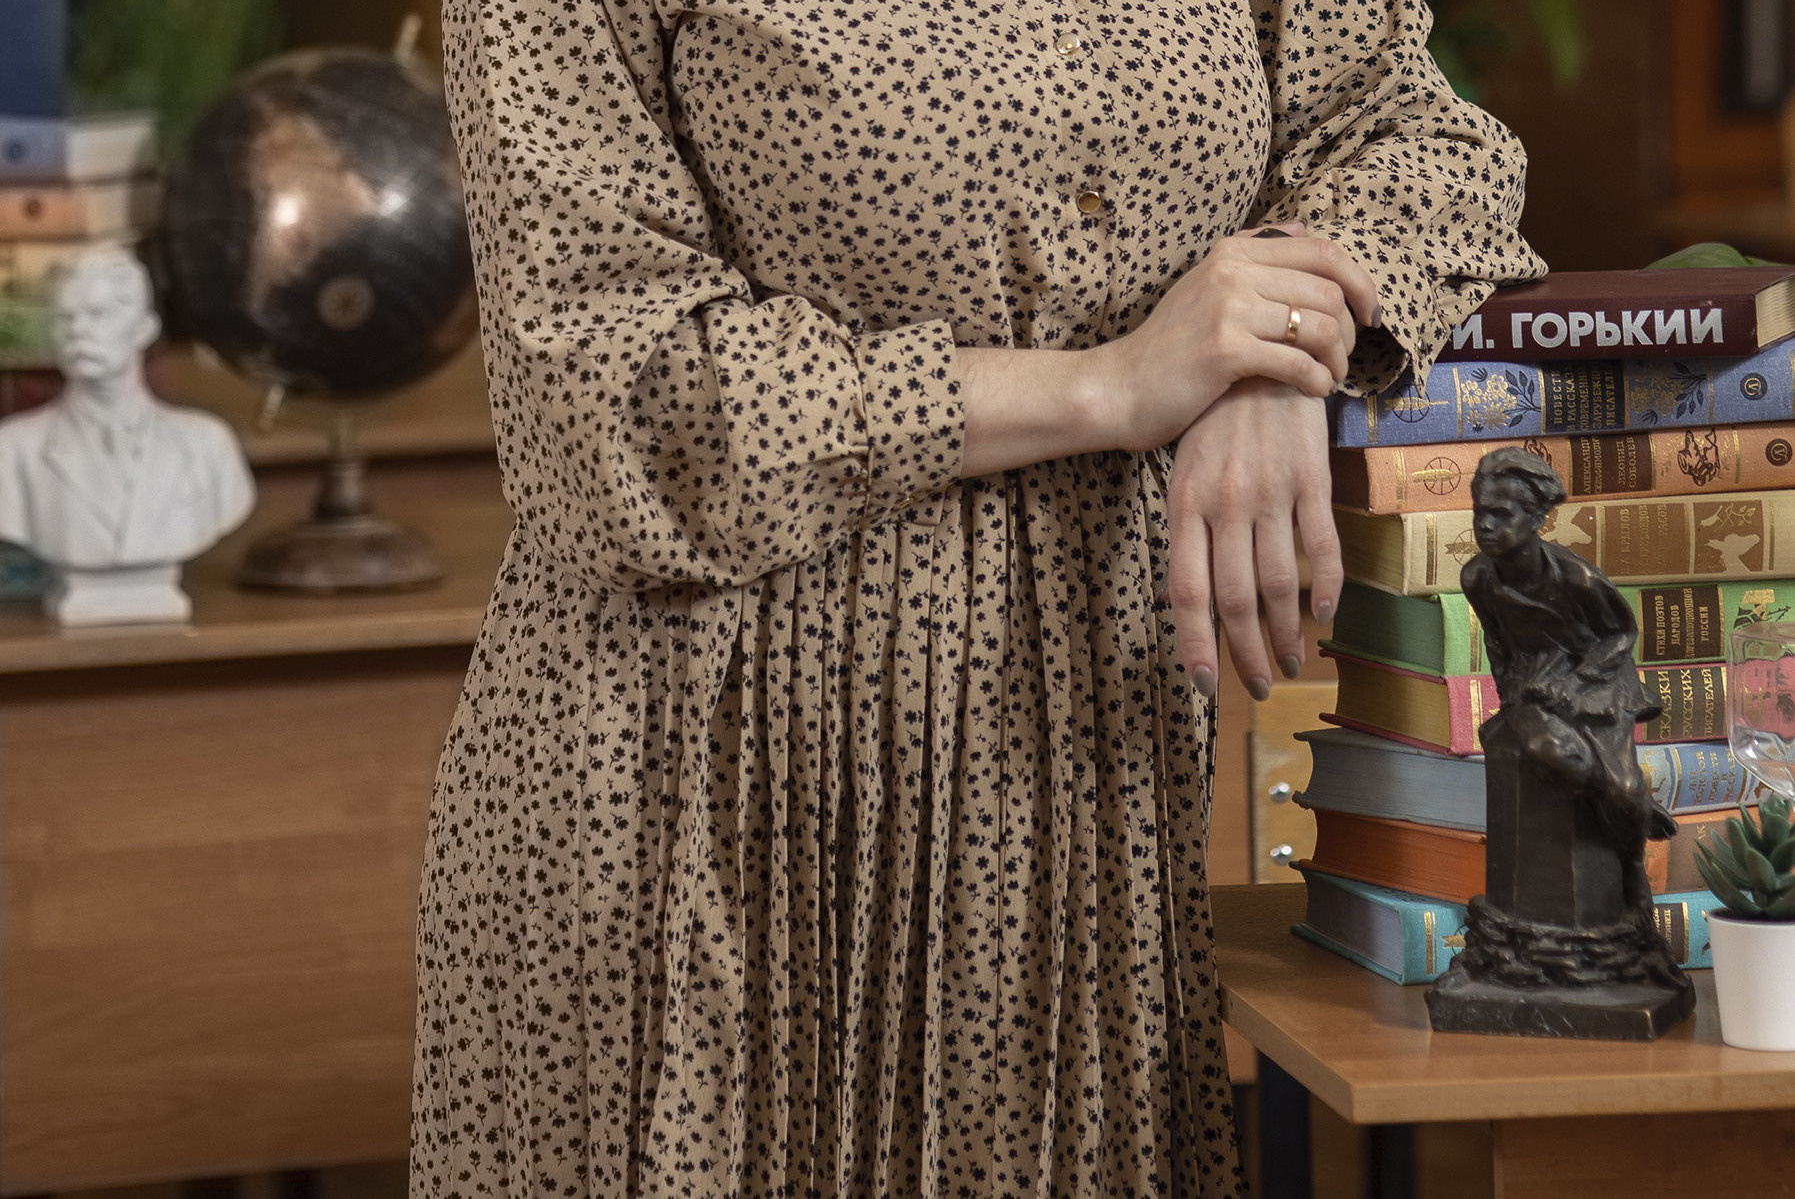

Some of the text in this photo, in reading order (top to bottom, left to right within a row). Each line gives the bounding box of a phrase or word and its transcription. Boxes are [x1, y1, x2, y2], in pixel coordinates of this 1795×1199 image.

[1581, 437, 1591, 494] АЛЕКСАНДР
[1616, 441, 1626, 485] ЛЕОНИД
[1626, 437, 1636, 488] СОБОЛЕВ
[1620, 508, 1631, 552] КРЫЛОВ
[1654, 595, 1666, 656] СТИХИ ПОЭТОВ
[1670, 605, 1680, 645] НАРОДОВ
[1699, 606, 1709, 641] РОССИИ
[1657, 670, 1672, 739] СКАЗКИ
[1680, 669, 1693, 738] РУССКИХ
[1701, 668, 1714, 737] ПИСАТЕЛЕЙ
